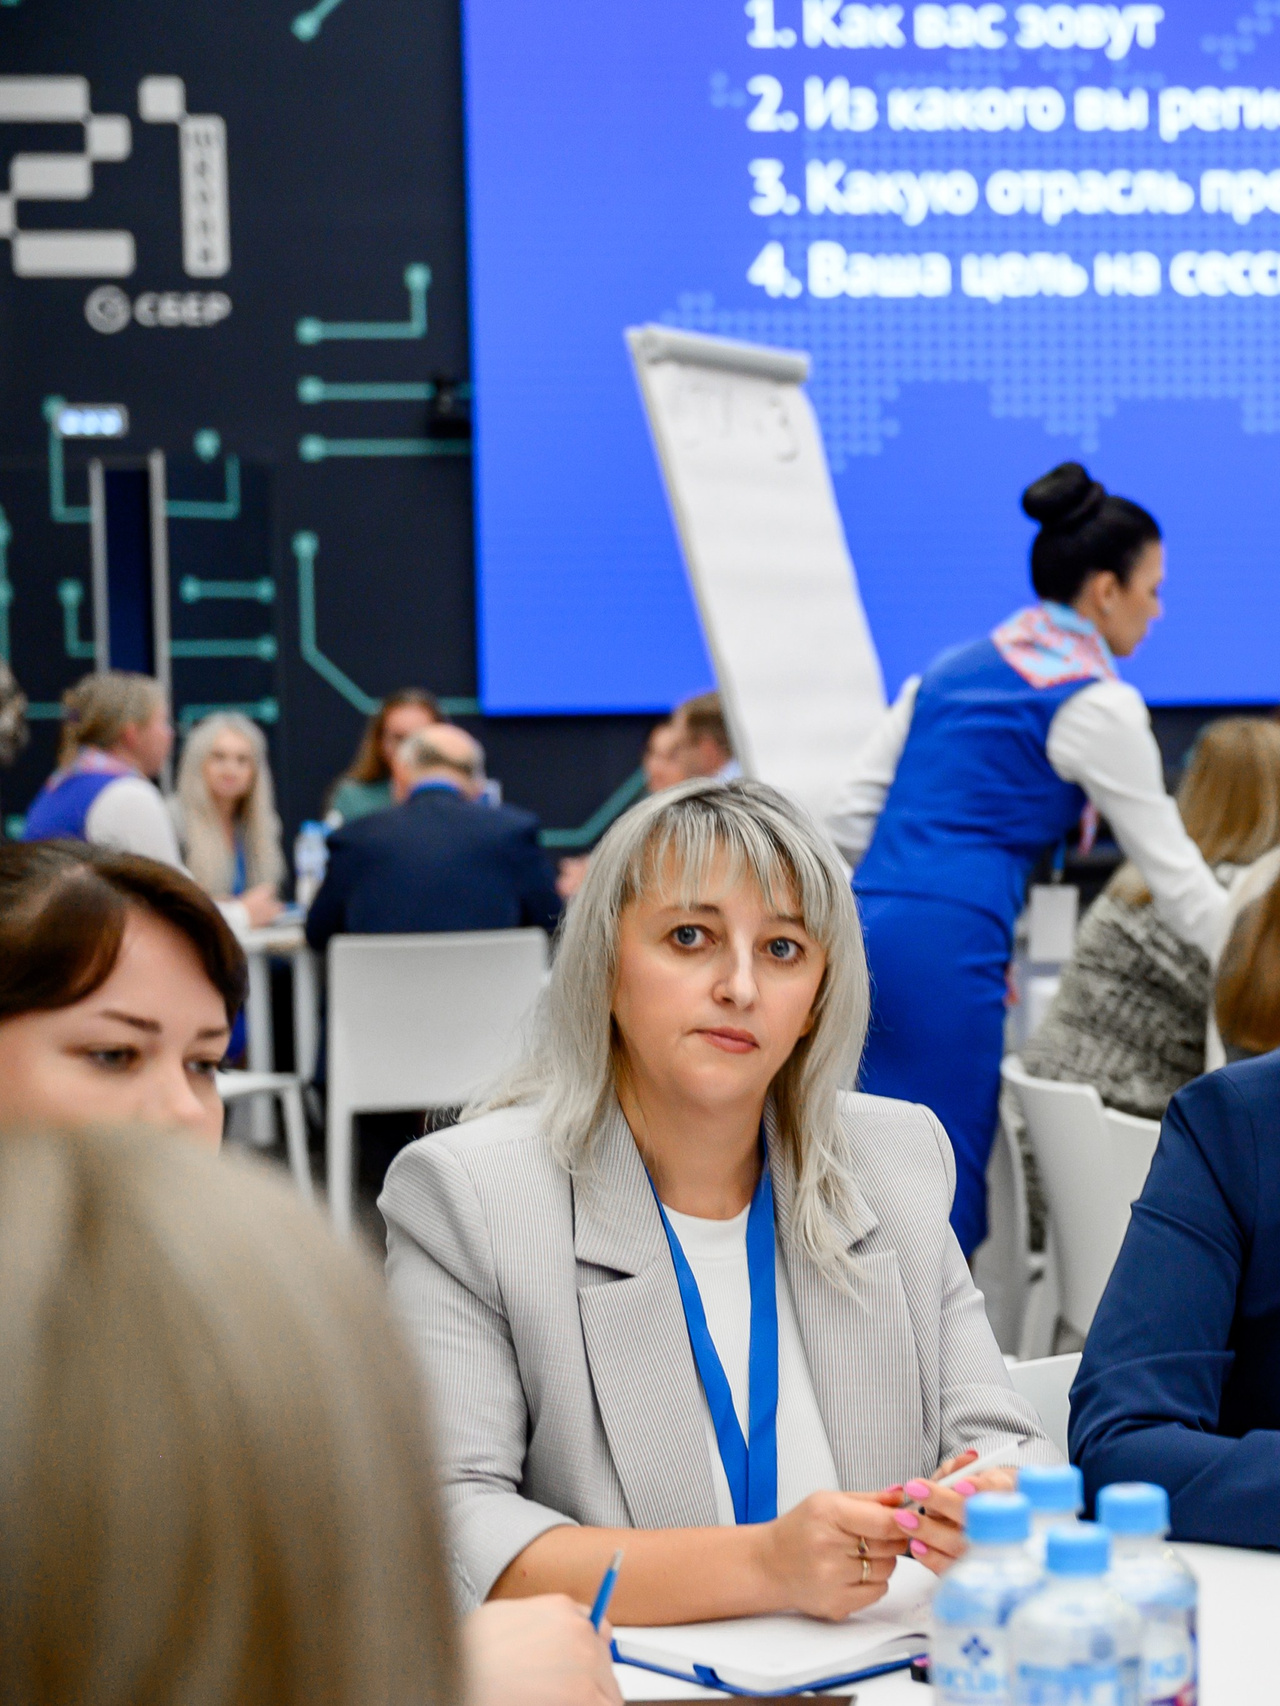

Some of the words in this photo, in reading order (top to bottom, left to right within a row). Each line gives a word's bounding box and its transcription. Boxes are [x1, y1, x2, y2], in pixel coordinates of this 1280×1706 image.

[748, 0, 796, 48] 1.
[803, 0, 904, 48] Как
[914, 4, 1006, 49] вас
[1016, 4, 1163, 60] зовут
[748, 75, 798, 132] 2.
[804, 77, 878, 132] Из
[887, 86, 1066, 132] какого
[1074, 86, 1149, 132] вы
[750, 159, 800, 216] 3.
[806, 161, 979, 226] Какую
[985, 169, 1195, 225] отрасль
[748, 241, 802, 298] 4.
[807, 241, 952, 298] Ваша
[961, 251, 1089, 303] цель
[1093, 251, 1161, 297] на
